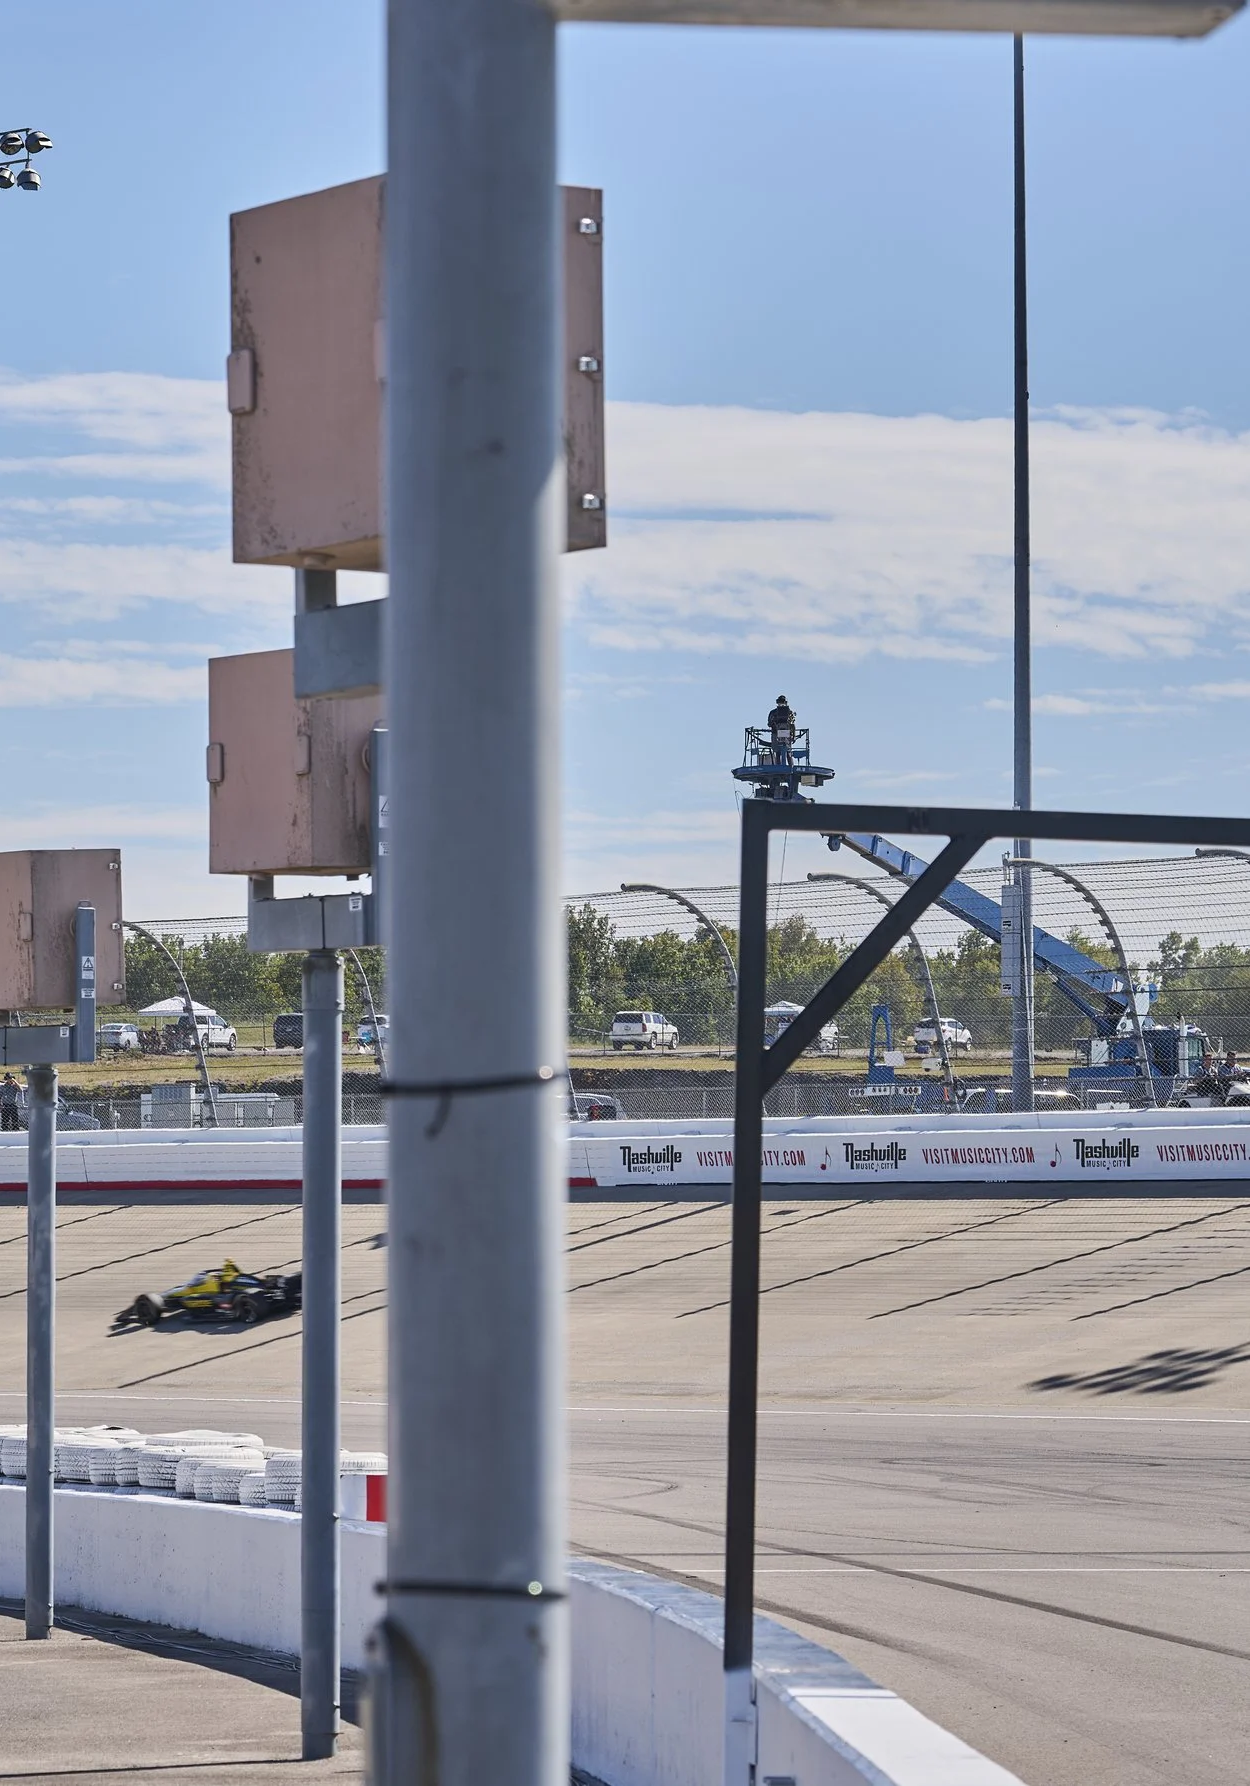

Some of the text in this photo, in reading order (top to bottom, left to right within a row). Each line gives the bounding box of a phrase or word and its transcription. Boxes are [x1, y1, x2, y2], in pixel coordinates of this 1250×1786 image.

[619, 1145, 682, 1173] Nashville
[696, 1150, 806, 1167] VISITMITY.COM
[843, 1142, 907, 1170] Nashville
[922, 1147, 1035, 1165] VISITMUSICCITY.COM
[1073, 1138, 1139, 1168] Nashville
[632, 1164, 670, 1173] MUSIC CITY
[880, 1162, 894, 1170] CITY
[1113, 1160, 1127, 1168] CITY
